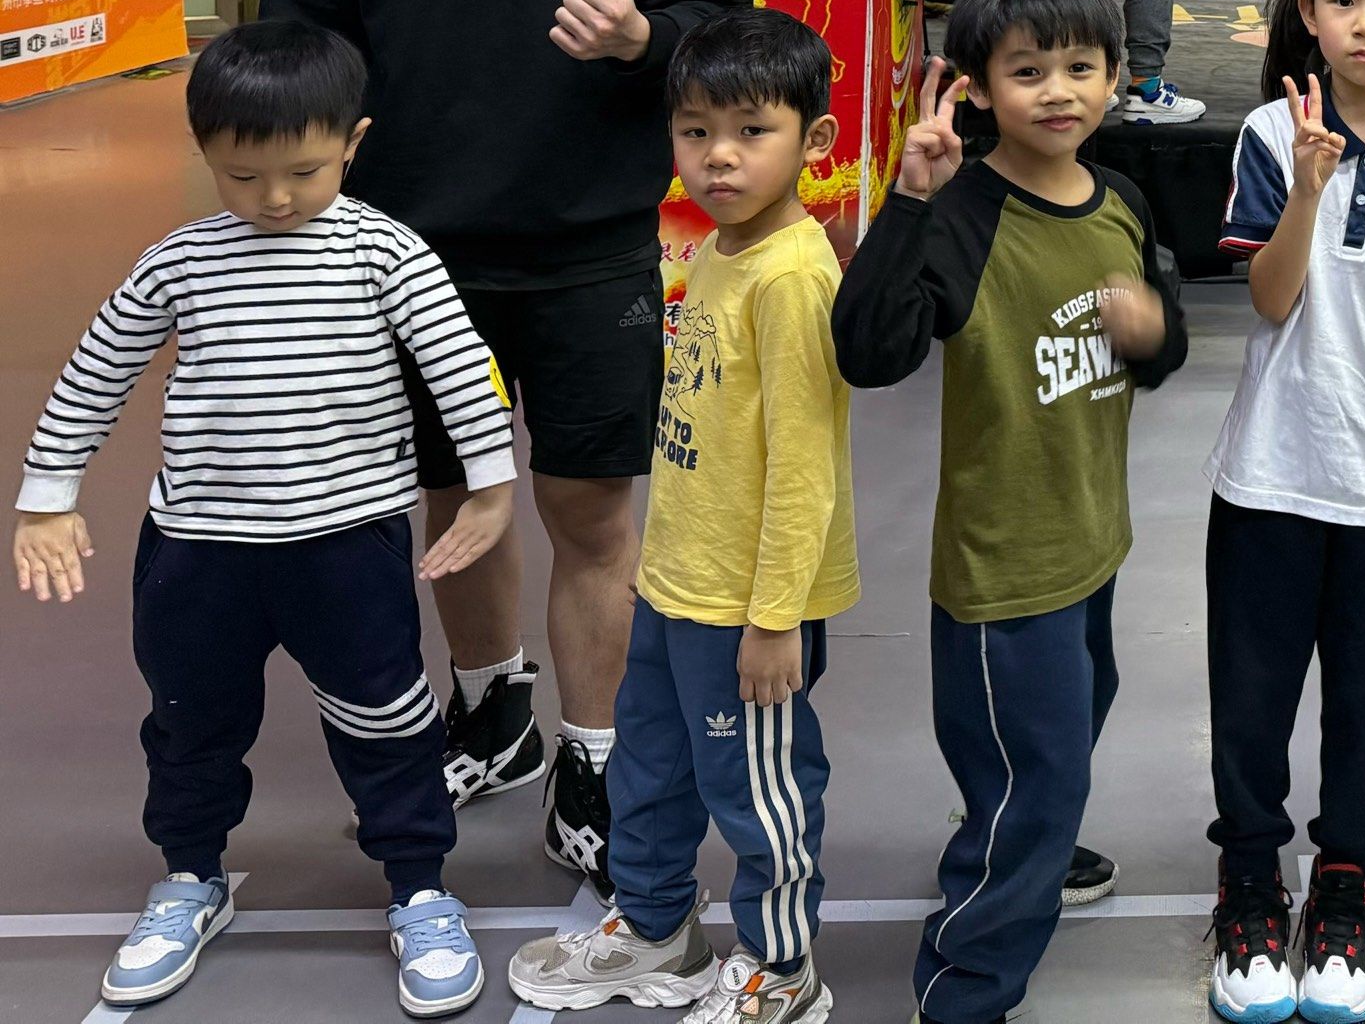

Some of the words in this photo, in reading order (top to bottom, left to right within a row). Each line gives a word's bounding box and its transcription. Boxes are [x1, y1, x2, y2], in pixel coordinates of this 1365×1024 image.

[619, 312, 657, 327] adidas
[674, 416, 692, 445] TO
[707, 729, 737, 738] adidas
